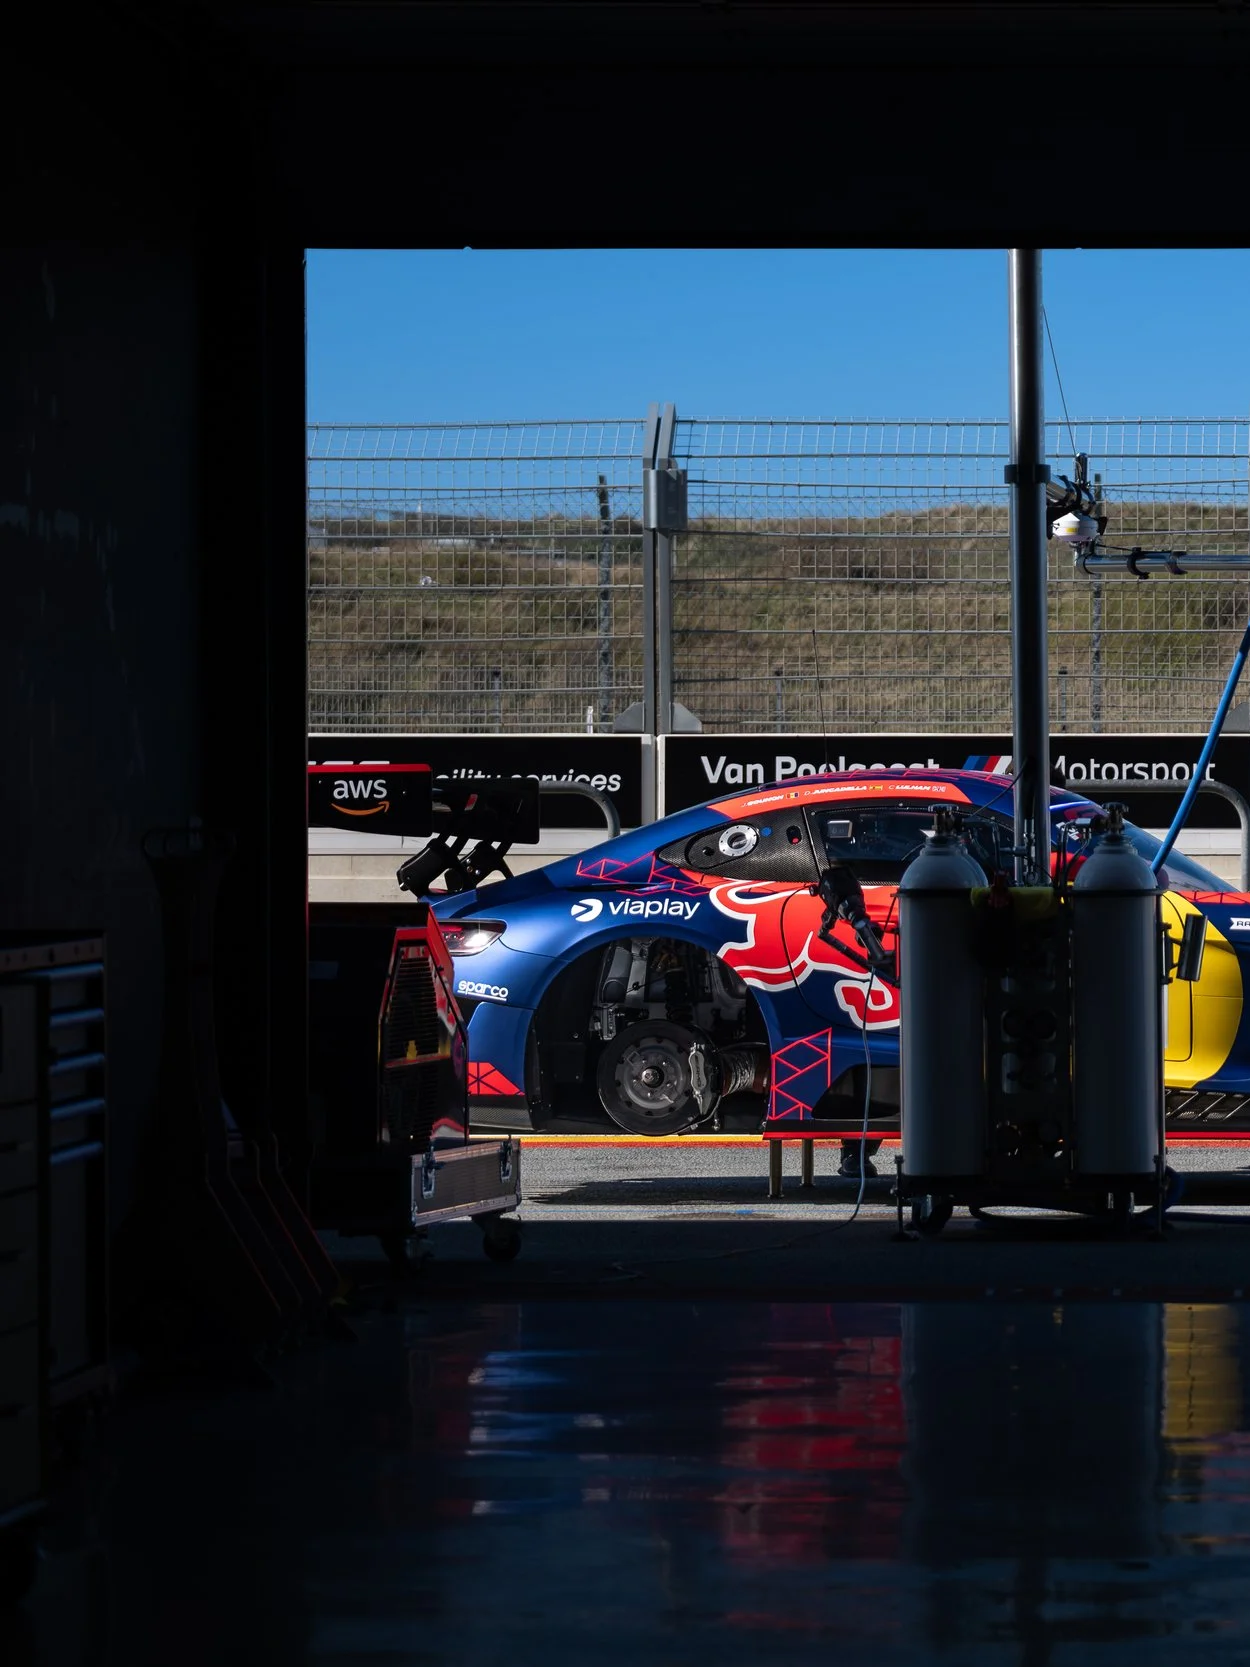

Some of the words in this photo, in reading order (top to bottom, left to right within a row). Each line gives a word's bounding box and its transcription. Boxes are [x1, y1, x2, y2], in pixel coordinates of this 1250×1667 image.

[700, 755, 765, 784] Van
[333, 778, 388, 800] aws
[609, 898, 701, 920] viaplay
[457, 979, 509, 1001] sparco
